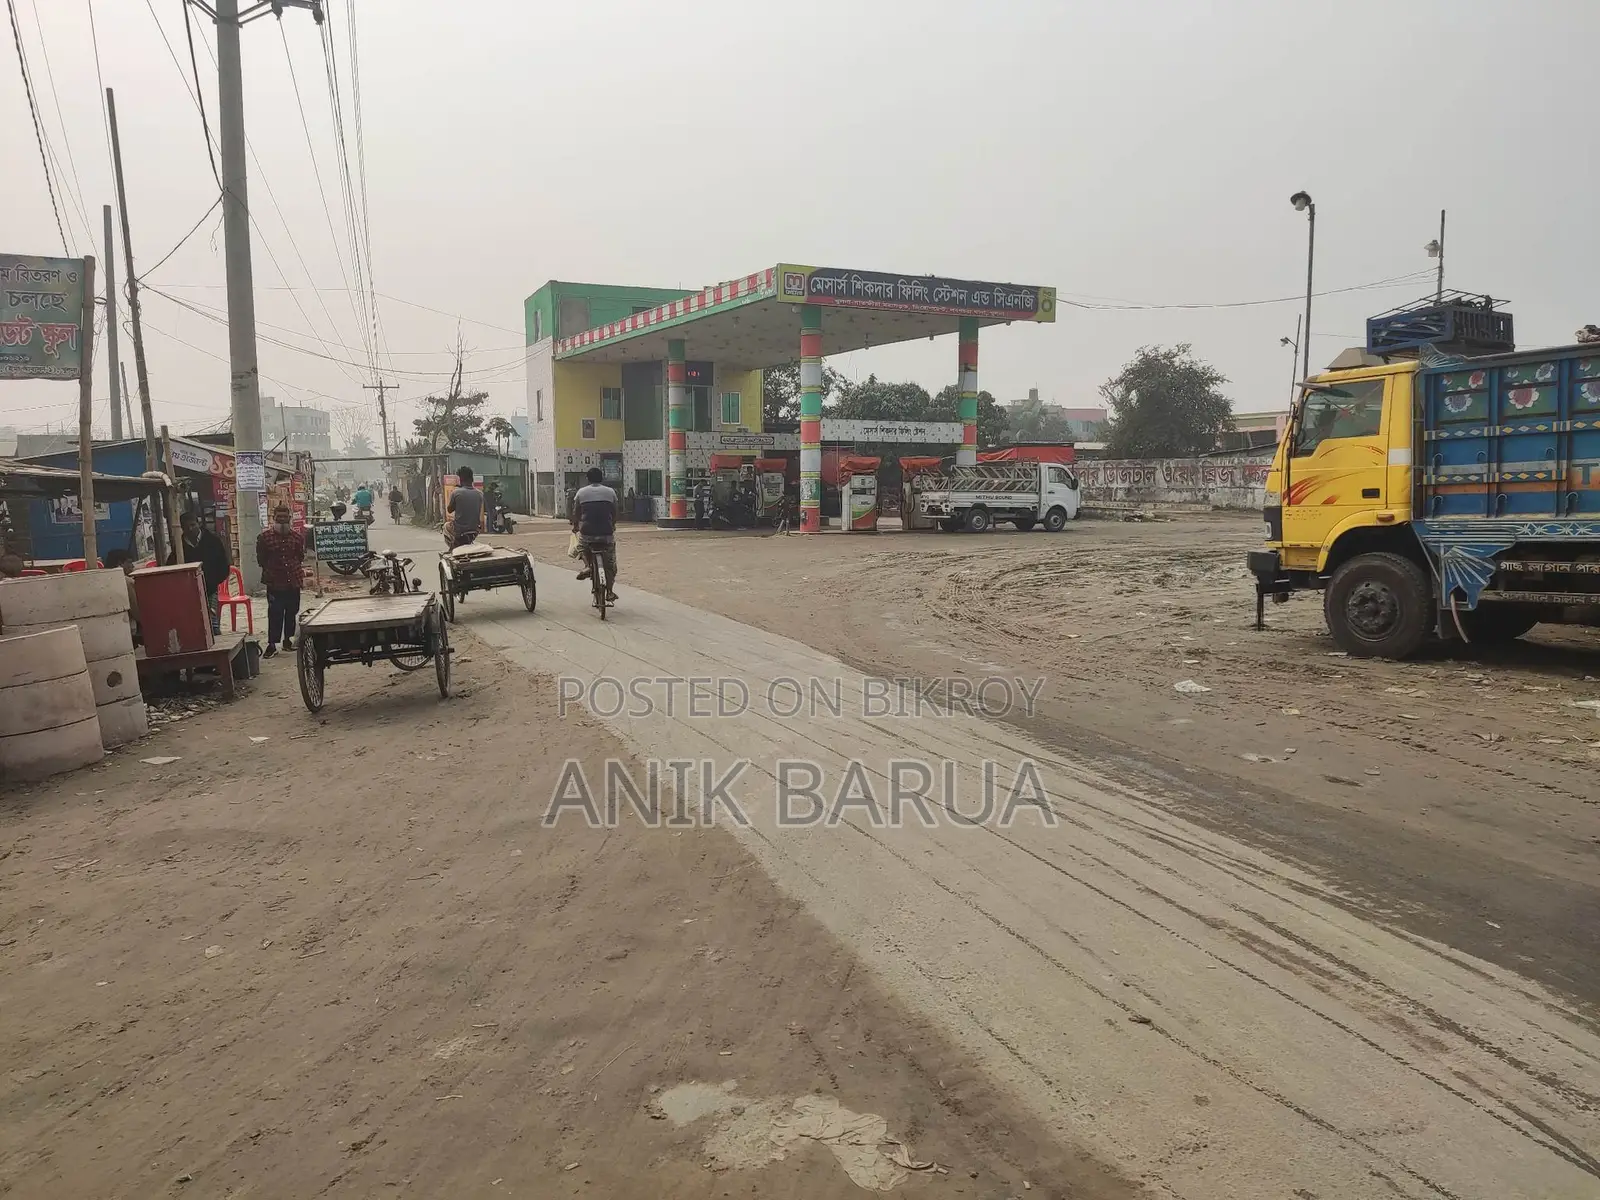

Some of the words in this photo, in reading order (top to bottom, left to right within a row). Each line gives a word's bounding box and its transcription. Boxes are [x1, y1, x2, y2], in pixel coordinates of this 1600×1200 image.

[15, 263, 61, 284] বিতরণ
[66, 270, 78, 284] ও
[5, 290, 69, 312] চলছে
[810, 273, 848, 295] মেসার্স
[851, 274, 894, 299] শিকদার
[897, 279, 930, 303] ফিলিং
[993, 287, 1035, 310] সিএনজি
[36, 322, 79, 359] স্কুল
[1103, 461, 1157, 485] ডিজিটাল
[1500, 561, 1524, 571] গাছ
[1528, 562, 1571, 572] লাগান
